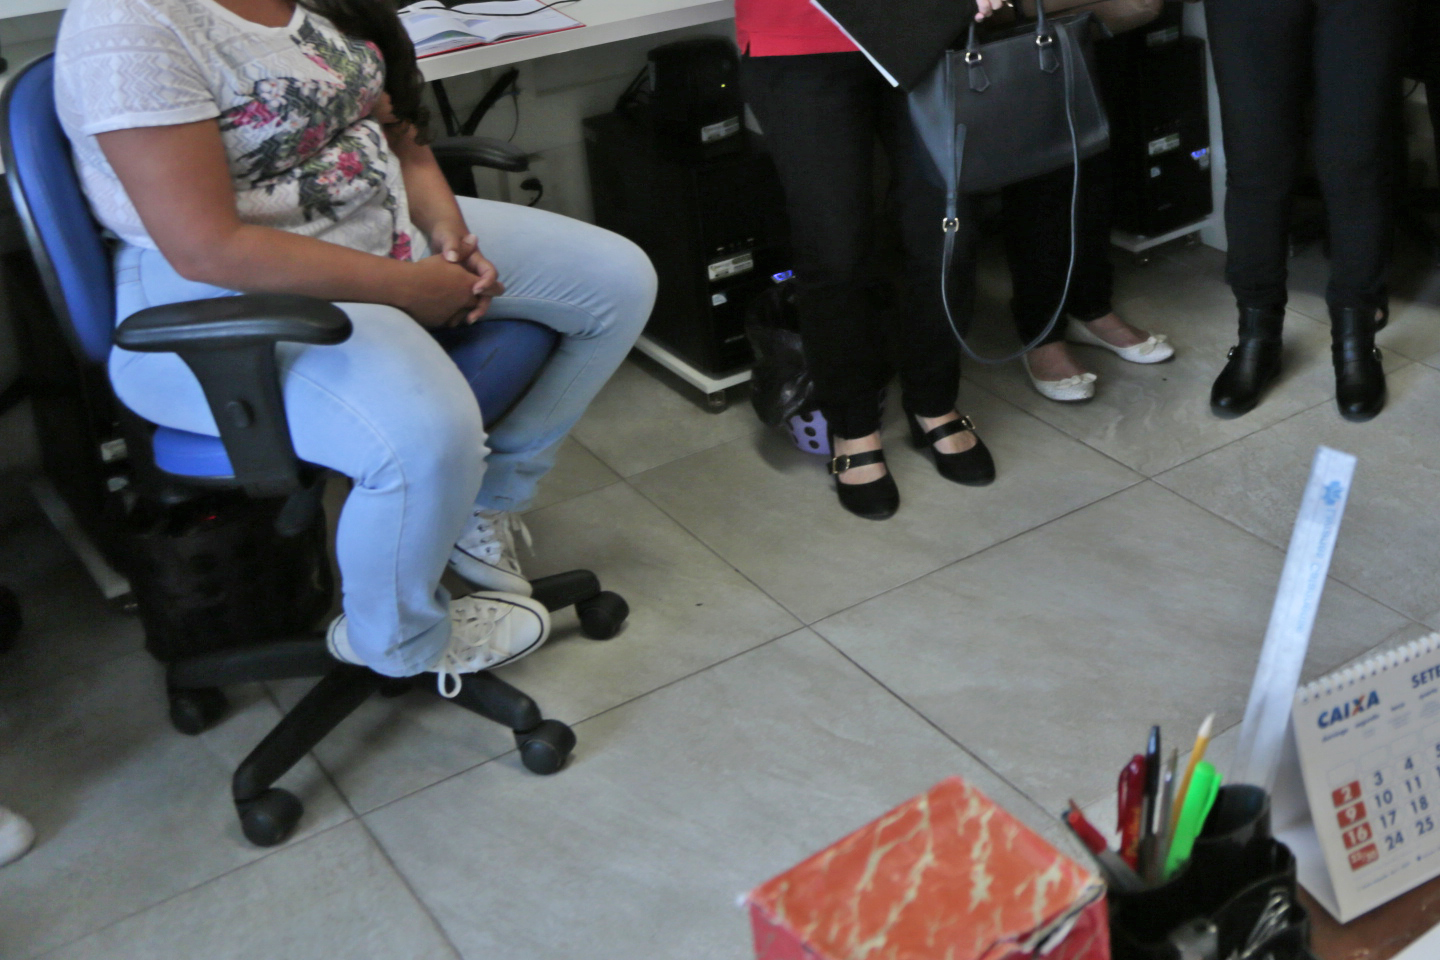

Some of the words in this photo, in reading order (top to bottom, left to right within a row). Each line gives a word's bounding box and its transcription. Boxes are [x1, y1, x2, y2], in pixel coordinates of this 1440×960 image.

[1317, 690, 1380, 729] CAIXA
[1340, 785, 1352, 802] 2
[1374, 770, 1384, 786] 3
[1404, 756, 1414, 771] 4
[1345, 807, 1357, 824] 9
[1375, 789, 1393, 808] 10
[1405, 775, 1421, 794] 11
[1347, 826, 1368, 846] 16
[1380, 808, 1396, 829] 17
[1411, 795, 1428, 814] 18
[1385, 830, 1404, 851] 24
[1415, 816, 1434, 836] 25
